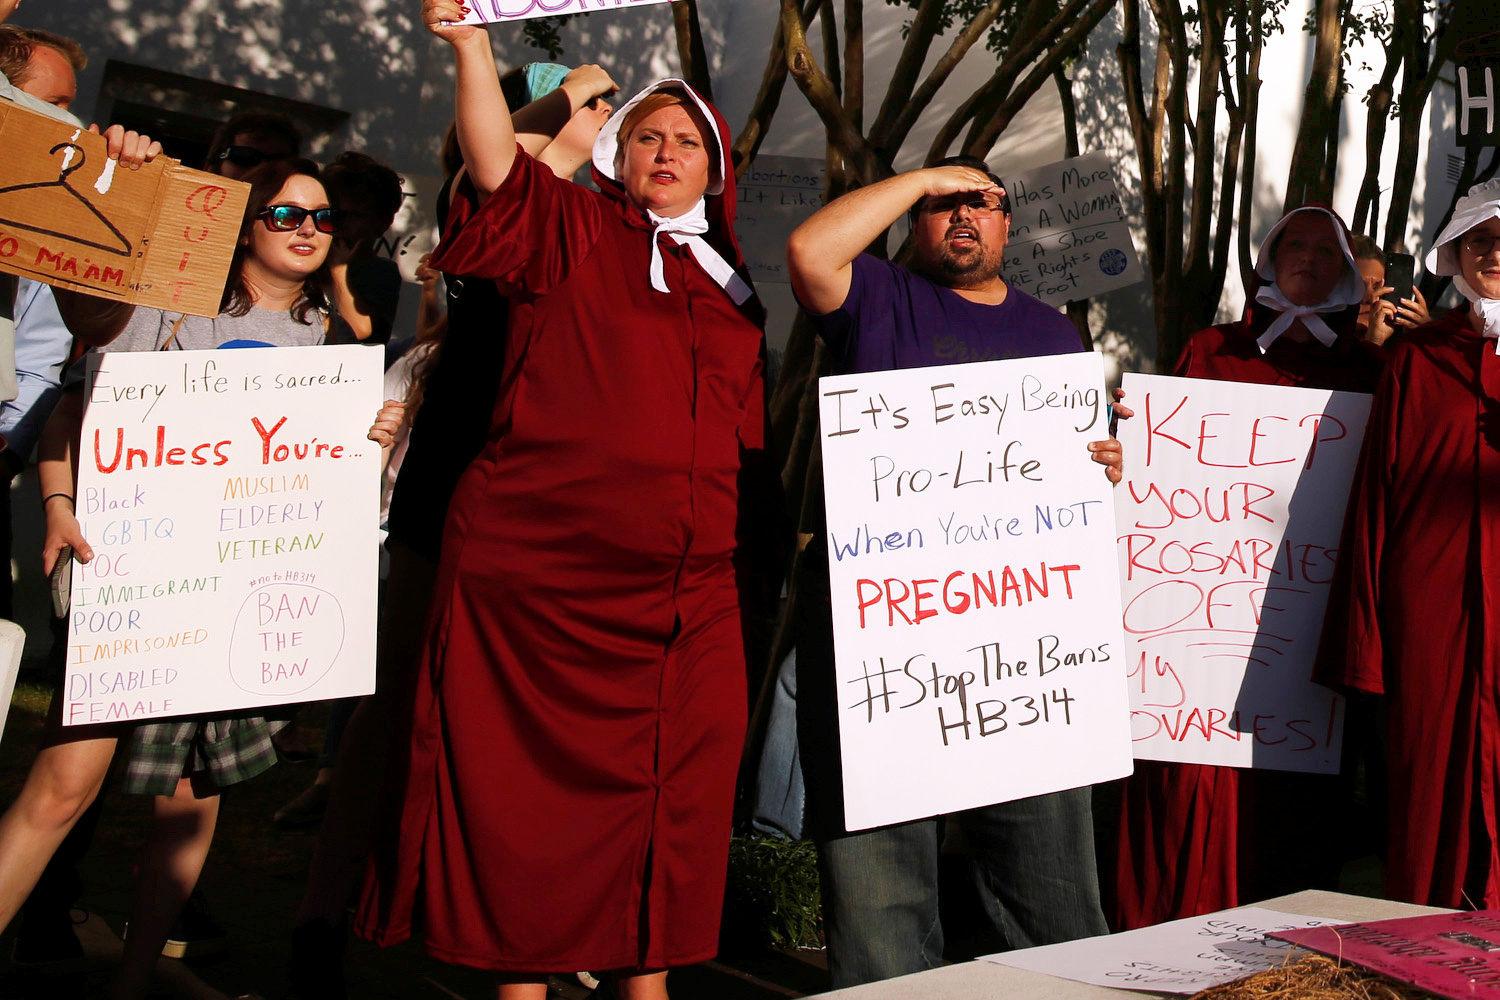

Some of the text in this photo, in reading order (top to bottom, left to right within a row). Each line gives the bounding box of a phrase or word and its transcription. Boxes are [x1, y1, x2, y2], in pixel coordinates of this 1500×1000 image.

[1013, 167, 1111, 208] Has More
[1039, 208, 1052, 229] A
[0, 231, 19, 258] O
[1033, 242, 1045, 260] A
[1058, 229, 1109, 252] Shoe
[1037, 252, 1091, 279] Rights
[90, 360, 363, 423] Every life is sacred...
[823, 374, 1100, 438] It's Easy Being
[94, 415, 363, 475] Unless You're...
[1145, 391, 1348, 471] KEEP
[223, 473, 310, 501] MUSLIM
[870, 440, 1044, 502] Pro-Life
[84, 483, 146, 515] Black
[1127, 479, 1275, 530] YOUR
[84, 516, 175, 549] LGBTQ
[219, 500, 324, 532] ELDERLY
[217, 532, 325, 563] VETERAN
[831, 523, 924, 562] When
[938, 511, 1023, 545] You're
[74, 576, 223, 607] IMMIGRANT
[856, 561, 1081, 629] PREGNANT
[1122, 579, 1311, 634] OFF
[74, 609, 142, 636] POOR
[258, 591, 321, 627] BAN
[71, 628, 209, 666] IMPRISONED
[258, 631, 304, 653] THE
[69, 667, 179, 701] DISABLED
[261, 657, 310, 685] BAN
[69, 698, 174, 726] FEMALE
